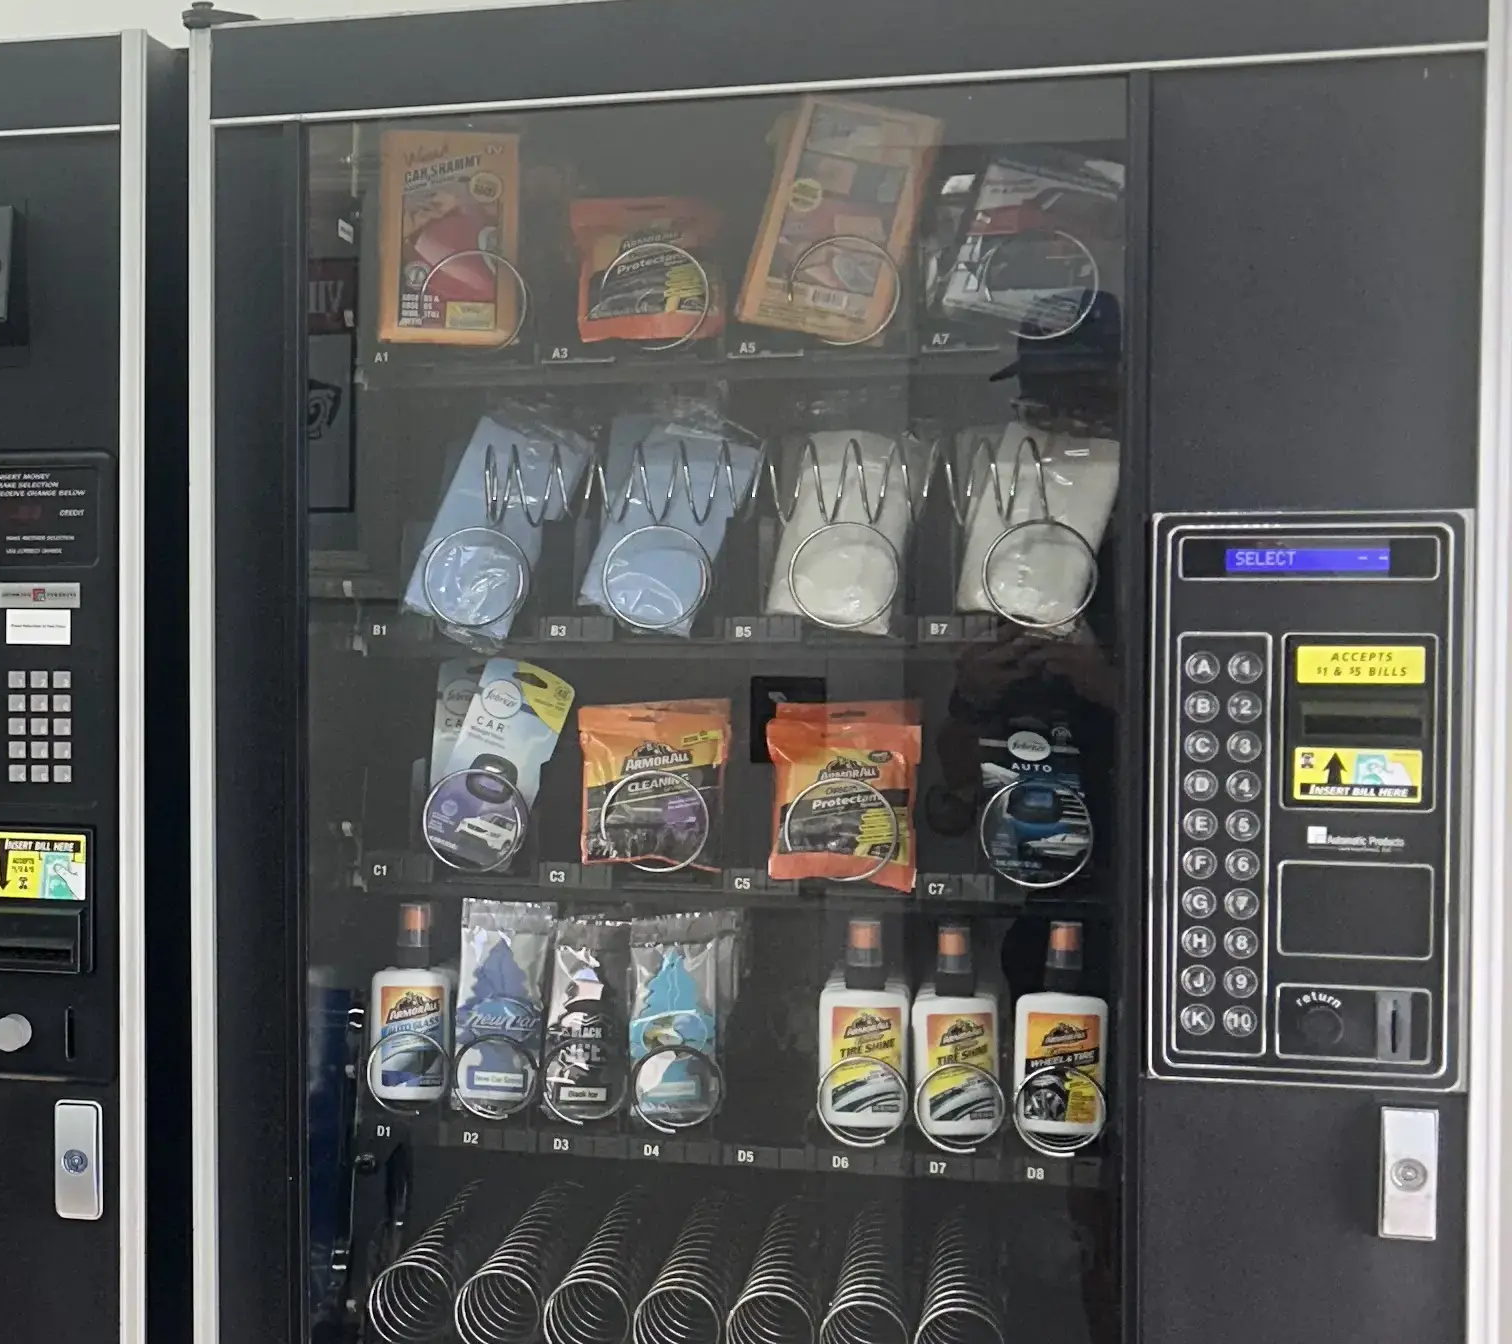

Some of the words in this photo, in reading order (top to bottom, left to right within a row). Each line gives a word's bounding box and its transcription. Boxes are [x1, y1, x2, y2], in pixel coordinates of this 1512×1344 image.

[932, 333, 950, 345] A7
[552, 348, 568, 359] A3
[739, 342, 755, 354] A5
[374, 352, 388, 363] A1
[1235, 550, 1296, 566] SELECT
[372, 624, 387, 636] B1
[550, 625, 567, 637] B3
[735, 626, 752, 638] B5
[930, 623, 948, 636] B7
[1331, 652, 1393, 662] ACCEPTS
[1197, 659, 1211, 674] A
[1369, 666, 1407, 677] BILLS
[1196, 698, 1210, 713] B
[1240, 699, 1252, 714] 2
[476, 715, 505, 733] CAR
[1195, 737, 1210, 753] C
[1239, 738, 1252, 754] 3
[1011, 762, 1053, 773] AUTO
[1195, 777, 1209, 792] D
[1239, 778, 1251, 792] 4
[1309, 785, 1349, 797] INSERT
[1351, 786, 1376, 797] BILL
[1379, 787, 1408, 798] HERE
[1195, 816, 1208, 831] E
[5, 838, 33, 850] INSERT
[1195, 856, 1206, 870] F
[1237, 857, 1249, 871] 6
[373, 864, 387, 876] C1
[549, 870, 566, 882] C3
[734, 877, 752, 890] C5
[928, 883, 944, 895] C7
[1193, 894, 1208, 909] G
[1193, 933, 1207, 948] H
[1236, 935, 1248, 950] 8
[1193, 973, 1205, 987] J
[1236, 974, 1248, 989] 9
[1296, 991, 1341, 1008] return
[1191, 1011, 1207, 1029] K
[1233, 1013, 1252, 1029] 10
[377, 1126, 391, 1137] D1
[463, 1132, 479, 1144] D2
[553, 1138, 569, 1150] D3
[644, 1145, 659, 1156] D4
[738, 1150, 754, 1162] D5
[832, 1156, 849, 1168] D6
[930, 1162, 947, 1174] D7
[1027, 1167, 1044, 1180] D8
